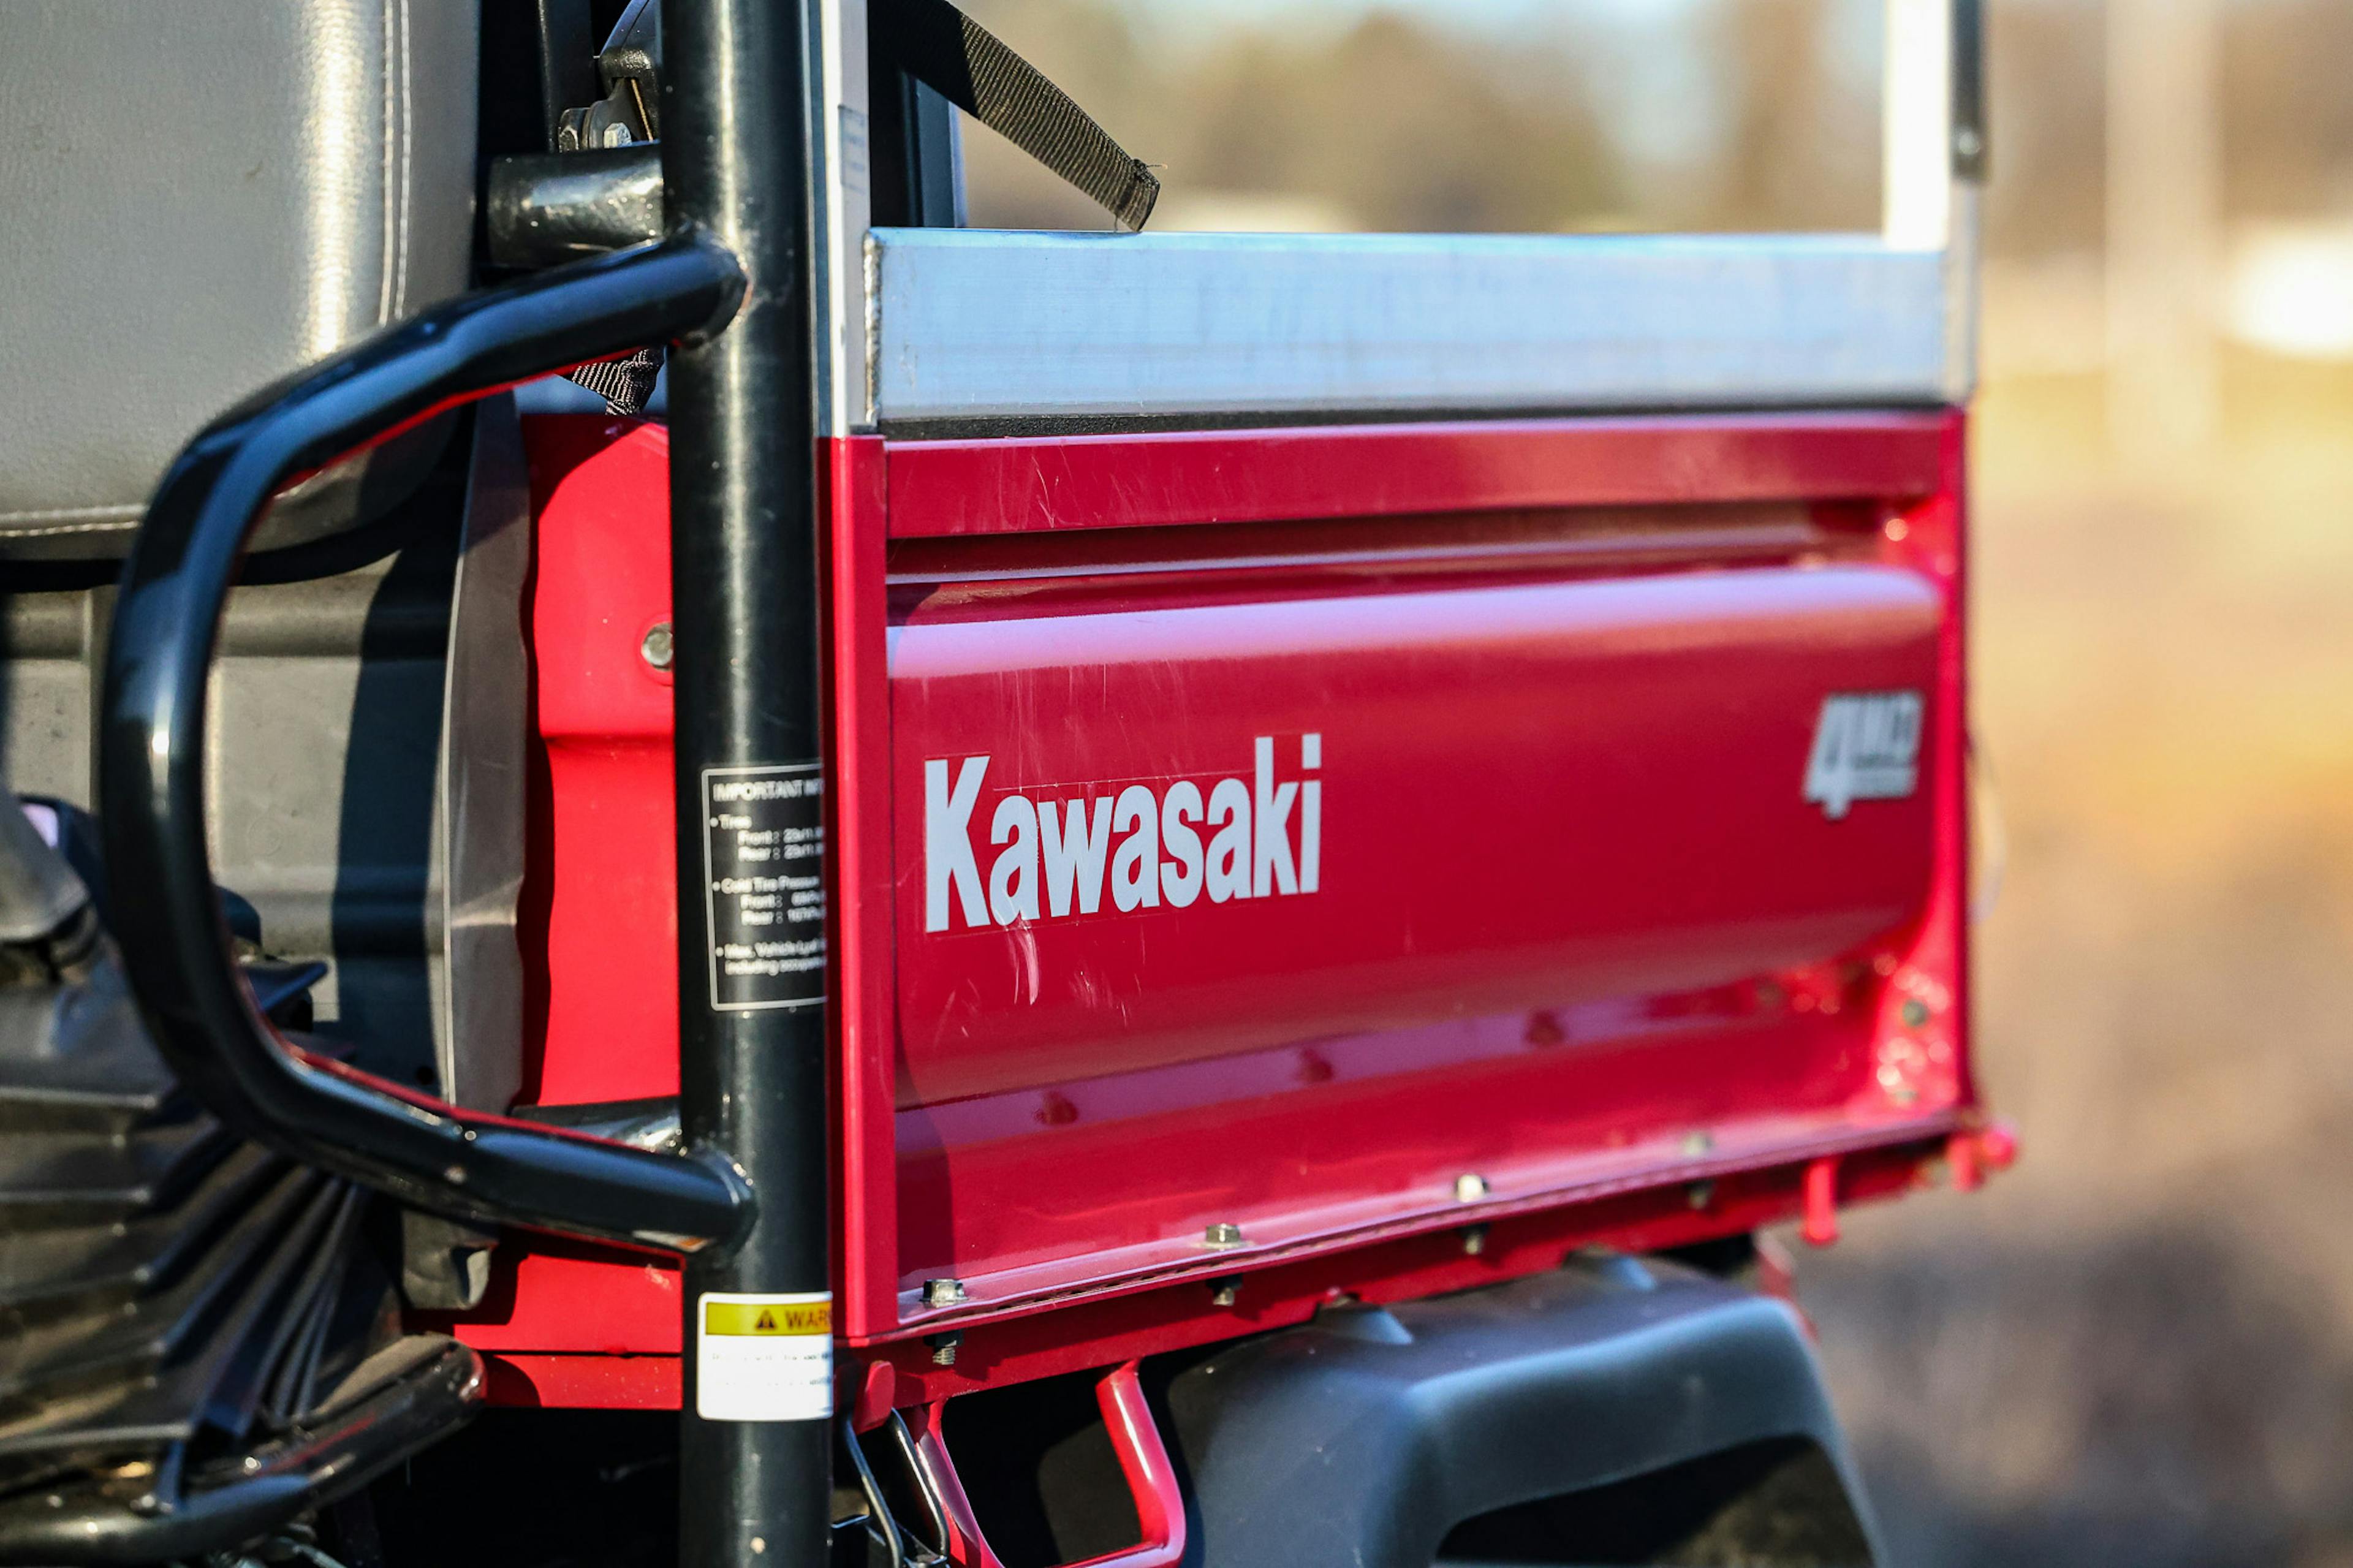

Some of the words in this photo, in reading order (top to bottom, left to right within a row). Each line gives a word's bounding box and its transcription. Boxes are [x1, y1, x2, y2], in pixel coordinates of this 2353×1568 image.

[713, 779, 803, 801] IMPORTANT
[719, 814, 752, 830] Tires
[925, 733, 1321, 933] Kawasaki
[784, 1308, 831, 1328] WAR
